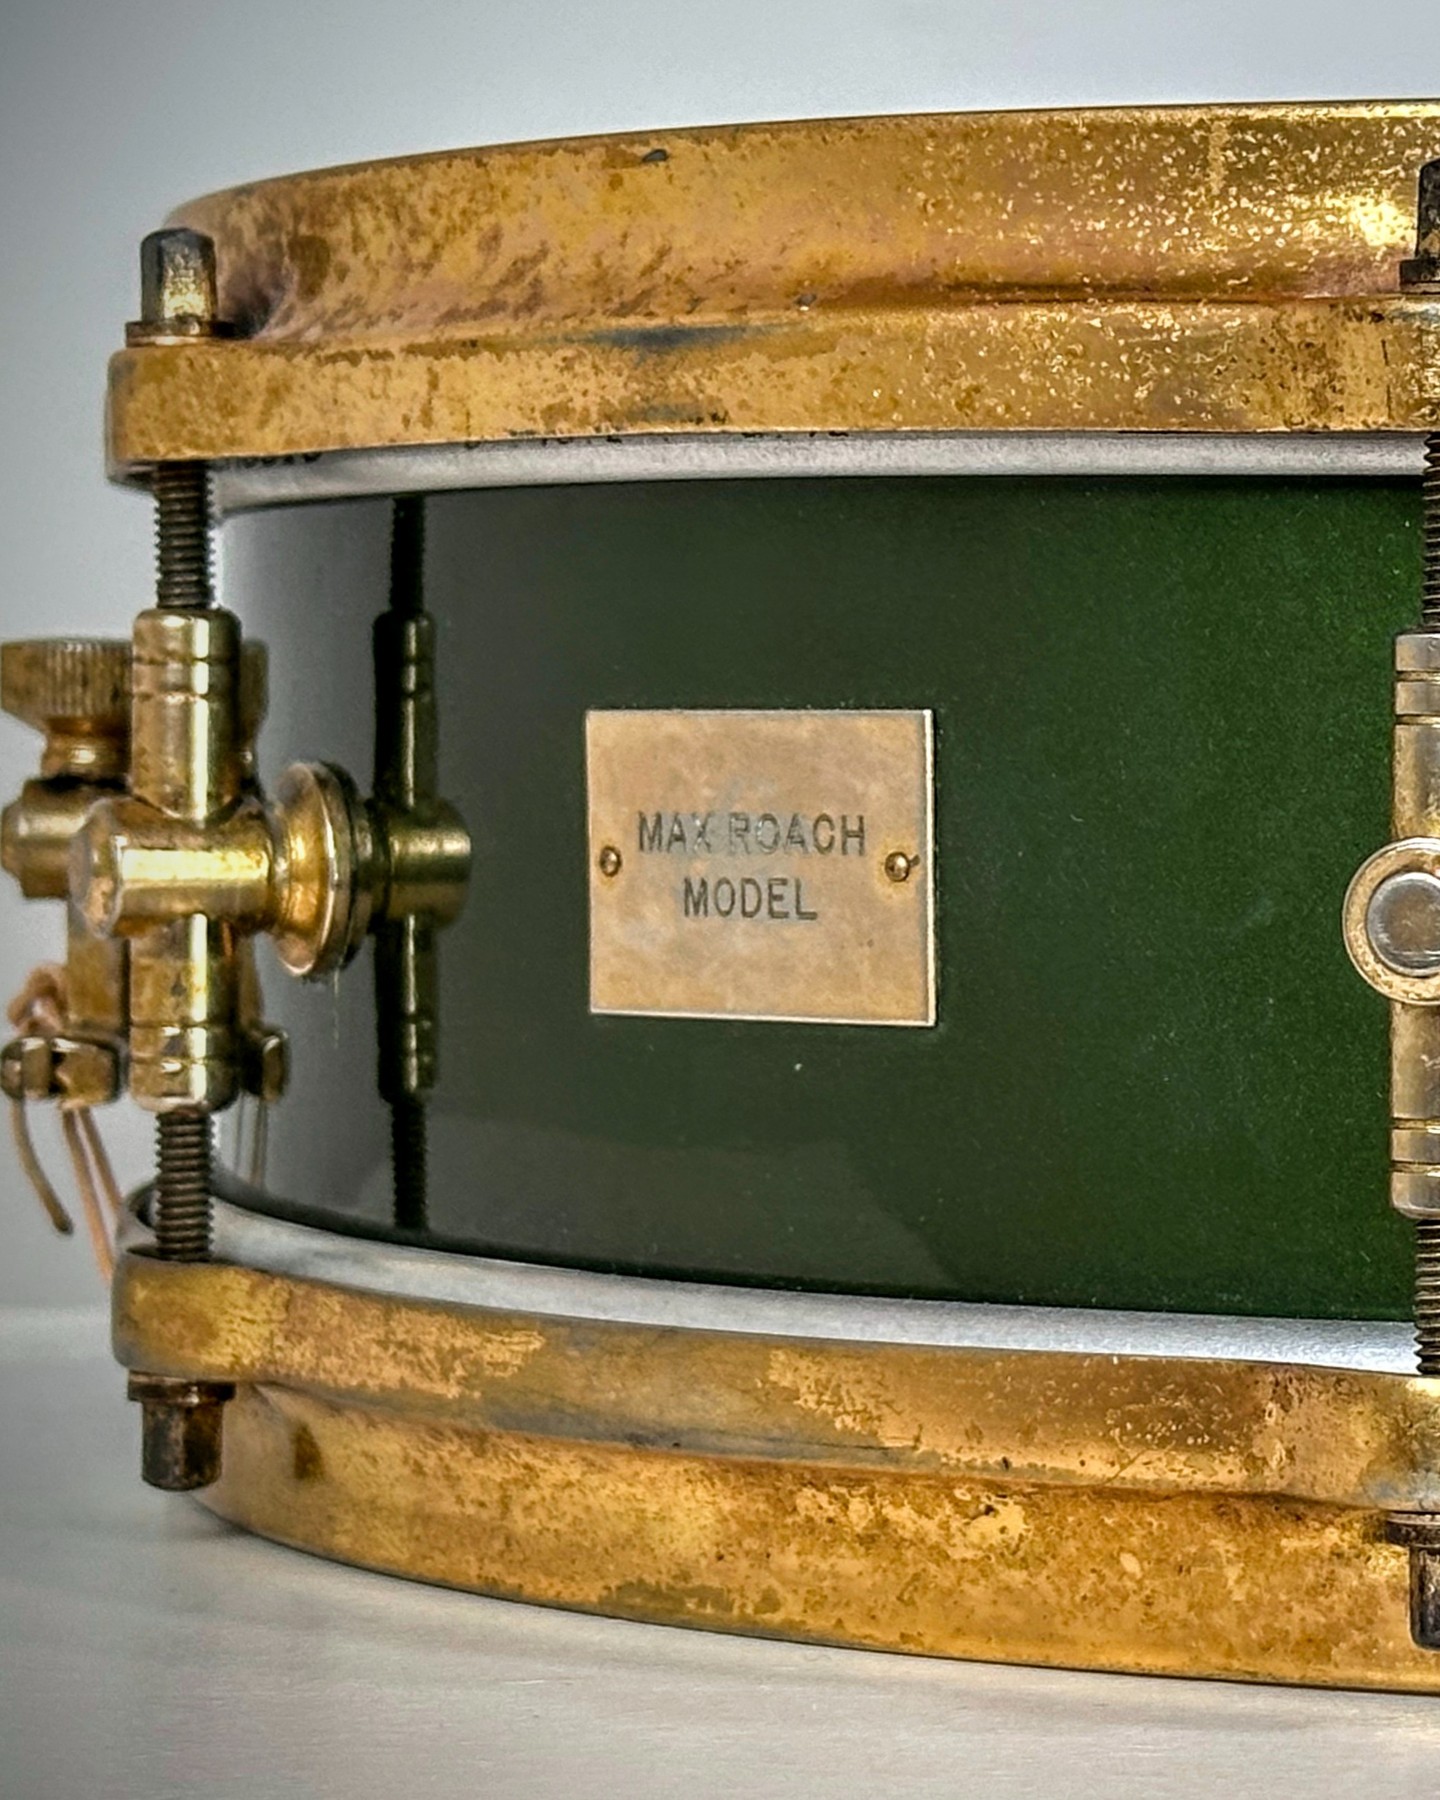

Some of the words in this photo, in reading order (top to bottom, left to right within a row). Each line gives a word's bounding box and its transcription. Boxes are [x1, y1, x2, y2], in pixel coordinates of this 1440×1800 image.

[638, 811, 712, 853] MAX
[728, 812, 866, 856] ROACH
[683, 877, 818, 921] MODEL
